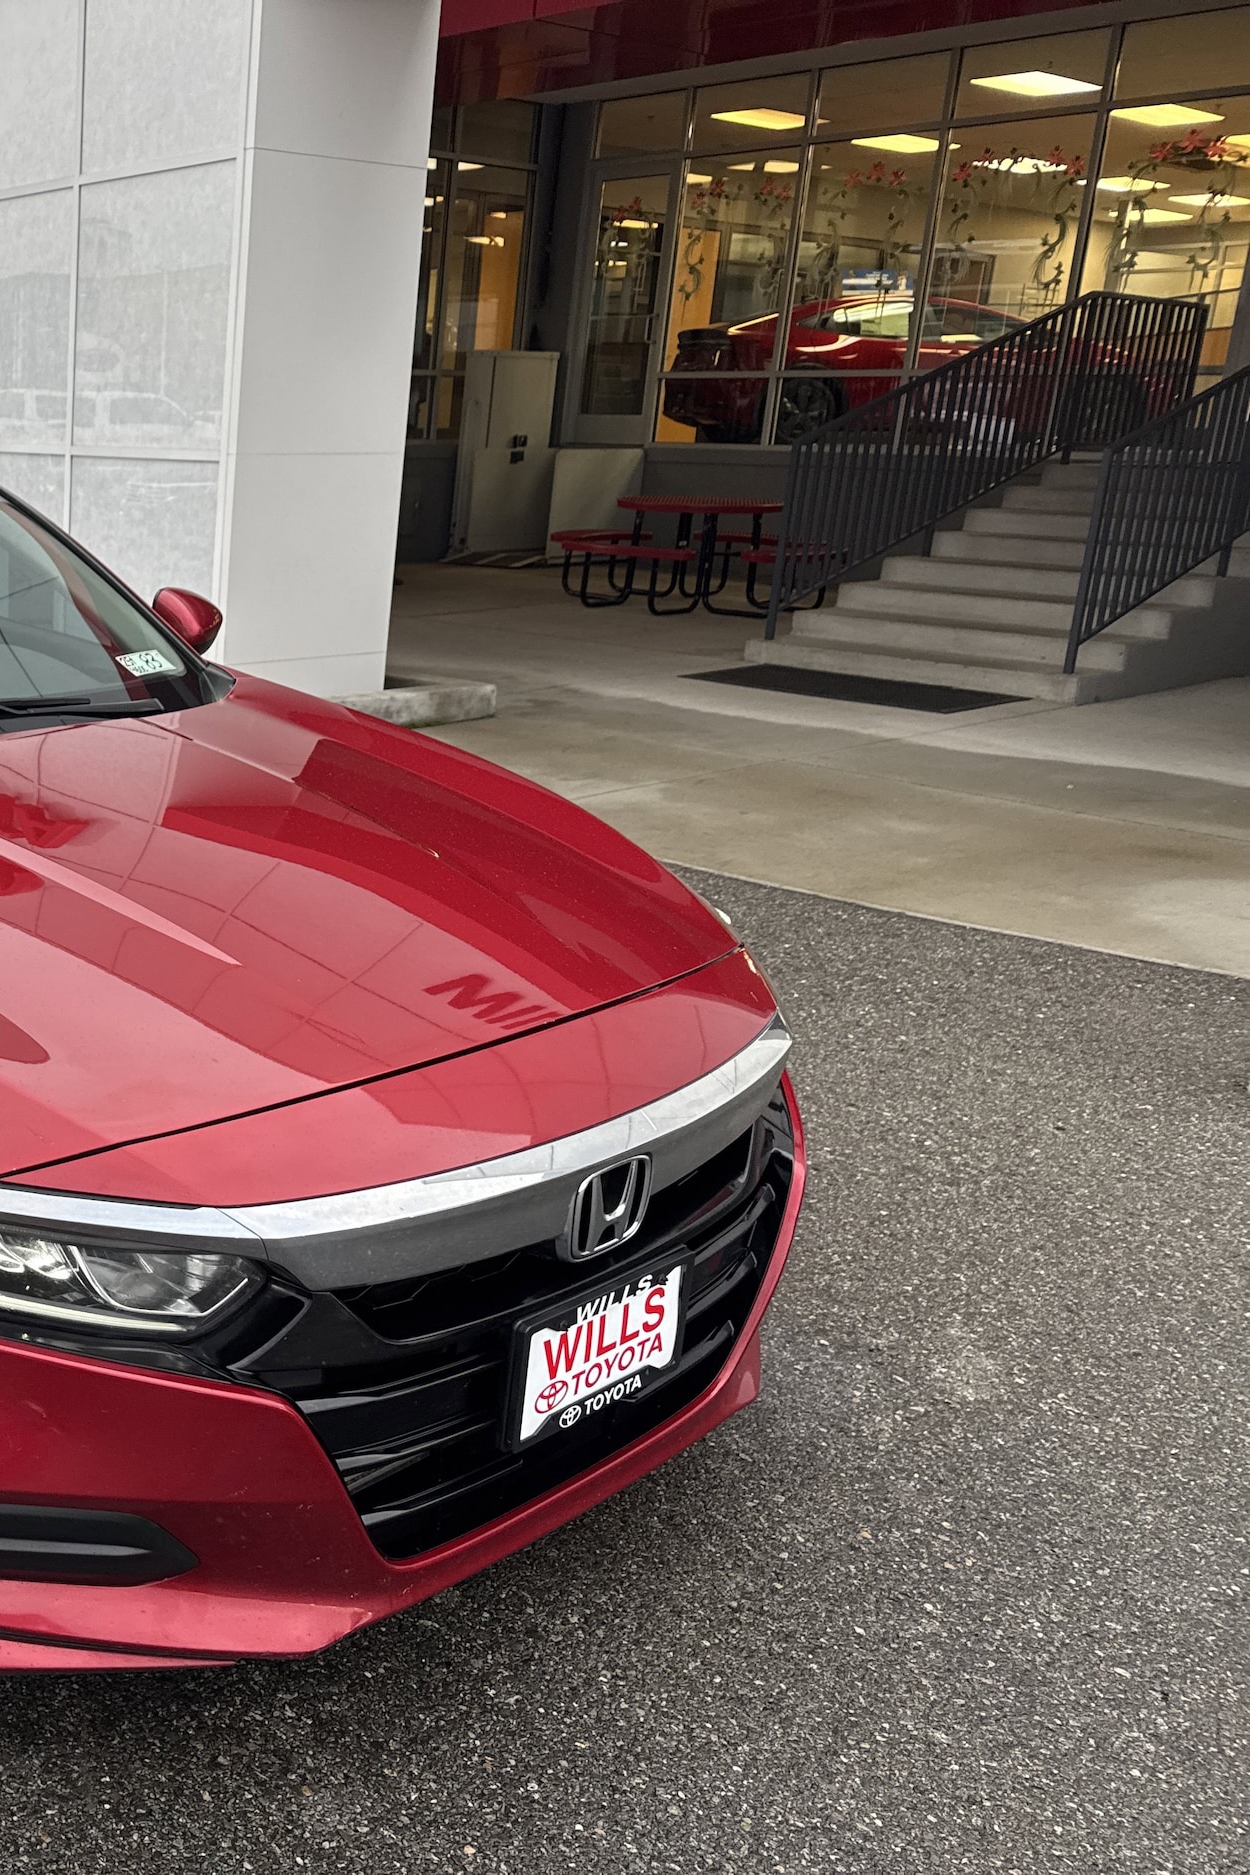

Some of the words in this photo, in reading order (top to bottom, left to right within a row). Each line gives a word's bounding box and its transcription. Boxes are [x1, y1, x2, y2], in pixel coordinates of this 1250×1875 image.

[576, 1274, 653, 1324] WILLS
[543, 1287, 665, 1380] WILLS
[571, 1332, 663, 1396] TOYOTA
[584, 1374, 642, 1415] TOYOTA
